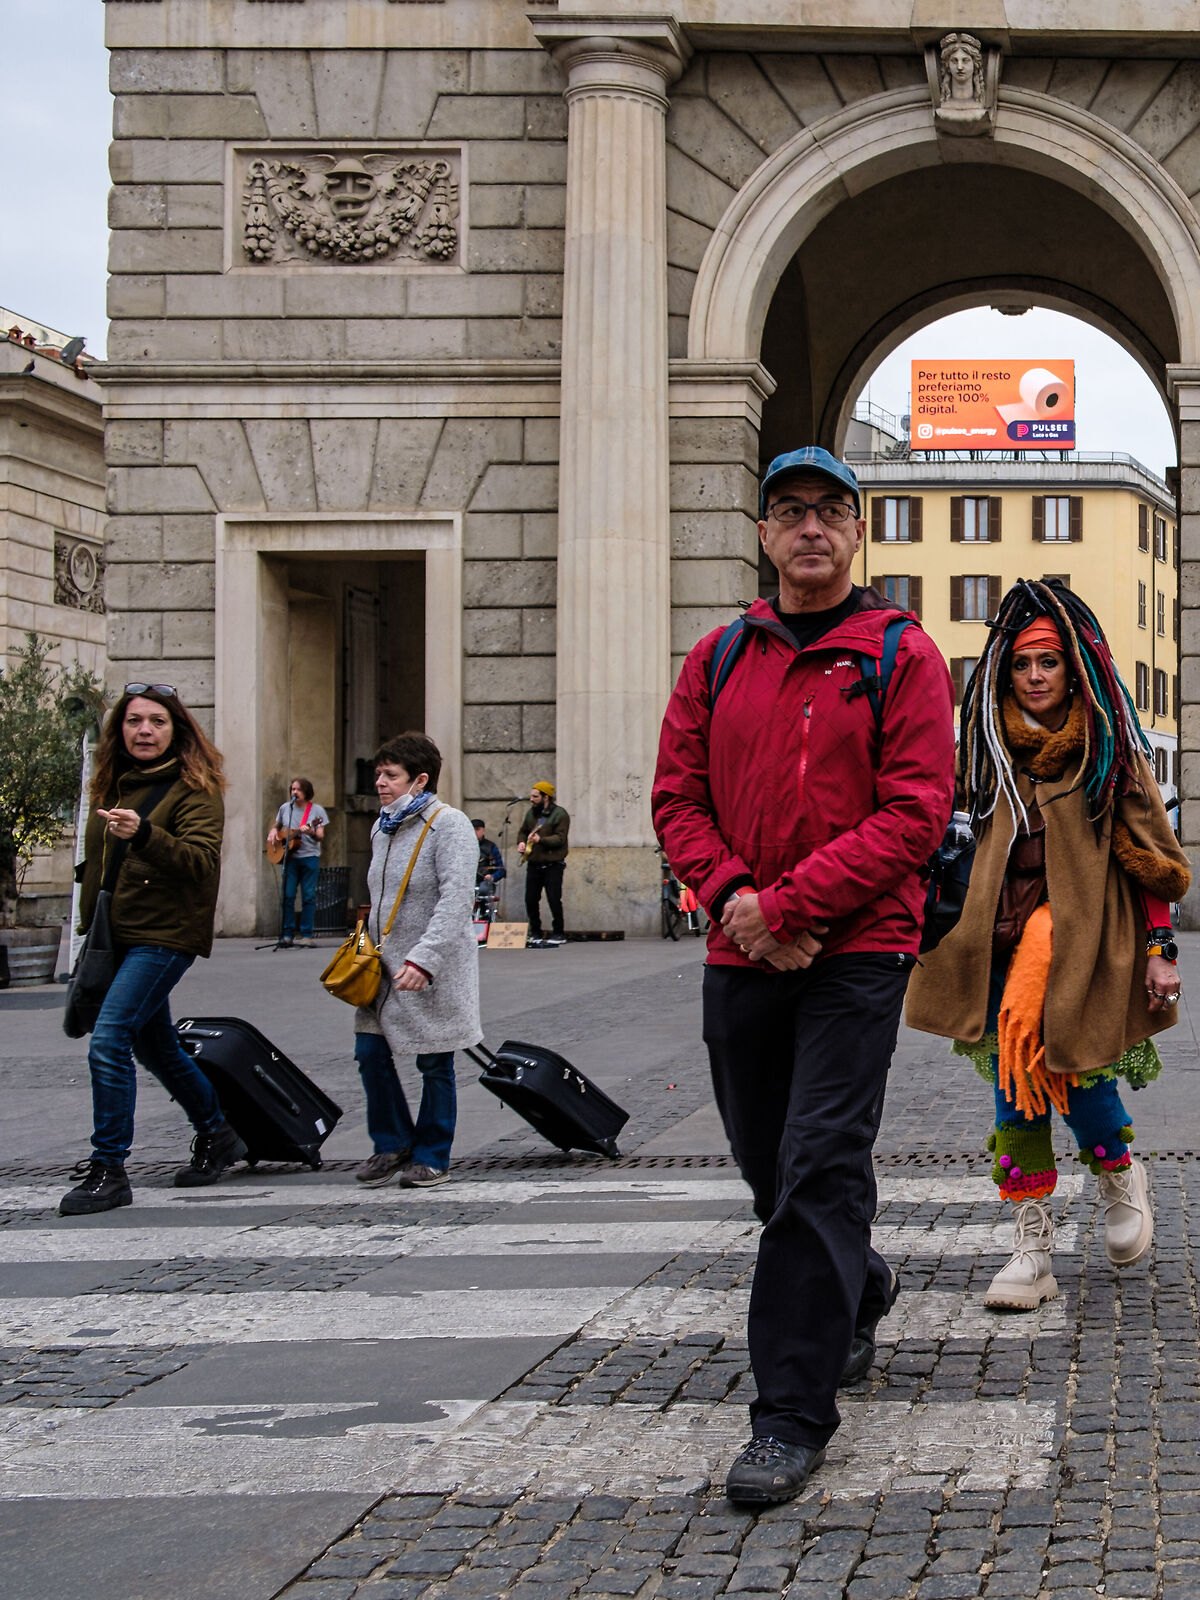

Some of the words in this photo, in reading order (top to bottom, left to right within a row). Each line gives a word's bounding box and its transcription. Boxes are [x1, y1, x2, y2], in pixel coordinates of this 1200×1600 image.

[918, 371, 937, 380] Per
[941, 371, 969, 380] tutto
[972, 371, 978, 380] il
[982, 371, 1011, 380] resto
[918, 382, 982, 392] preferiamo
[958, 393, 990, 403] 100%
[918, 404, 958, 415] digital.
[1032, 424, 1068, 432] PULSEE
